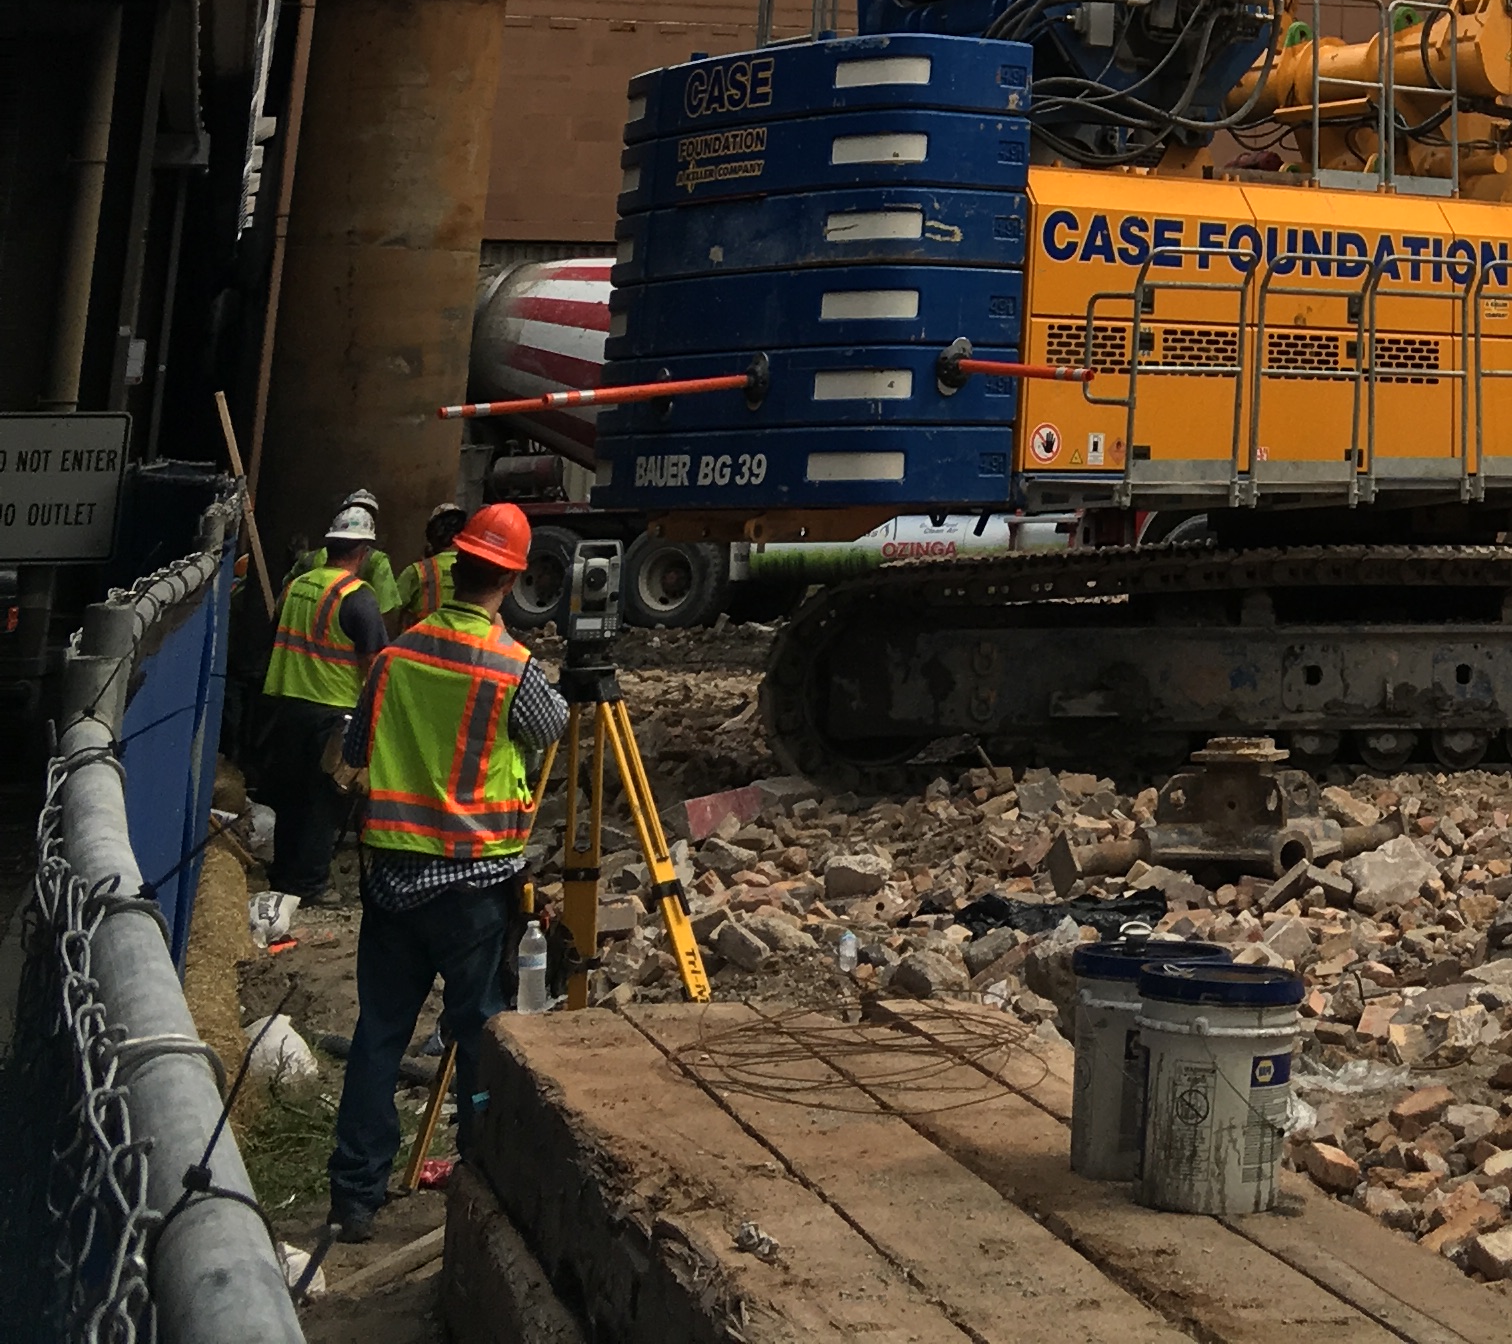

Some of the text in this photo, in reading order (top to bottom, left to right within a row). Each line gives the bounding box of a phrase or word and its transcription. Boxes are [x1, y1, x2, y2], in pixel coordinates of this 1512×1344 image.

[685, 58, 774, 118] CASE
[677, 127, 768, 163] FOUNDATION
[685, 166, 716, 184] KELLER
[717, 160, 766, 179] COMPANY
[1043, 209, 1511, 287] CASE FOUNDATION
[0, 449, 118, 473] O NOT ENTER
[635, 453, 767, 487] BAUER BG 39
[0, 502, 97, 527] O OUTLET
[882, 540, 957, 558] OZINGA
